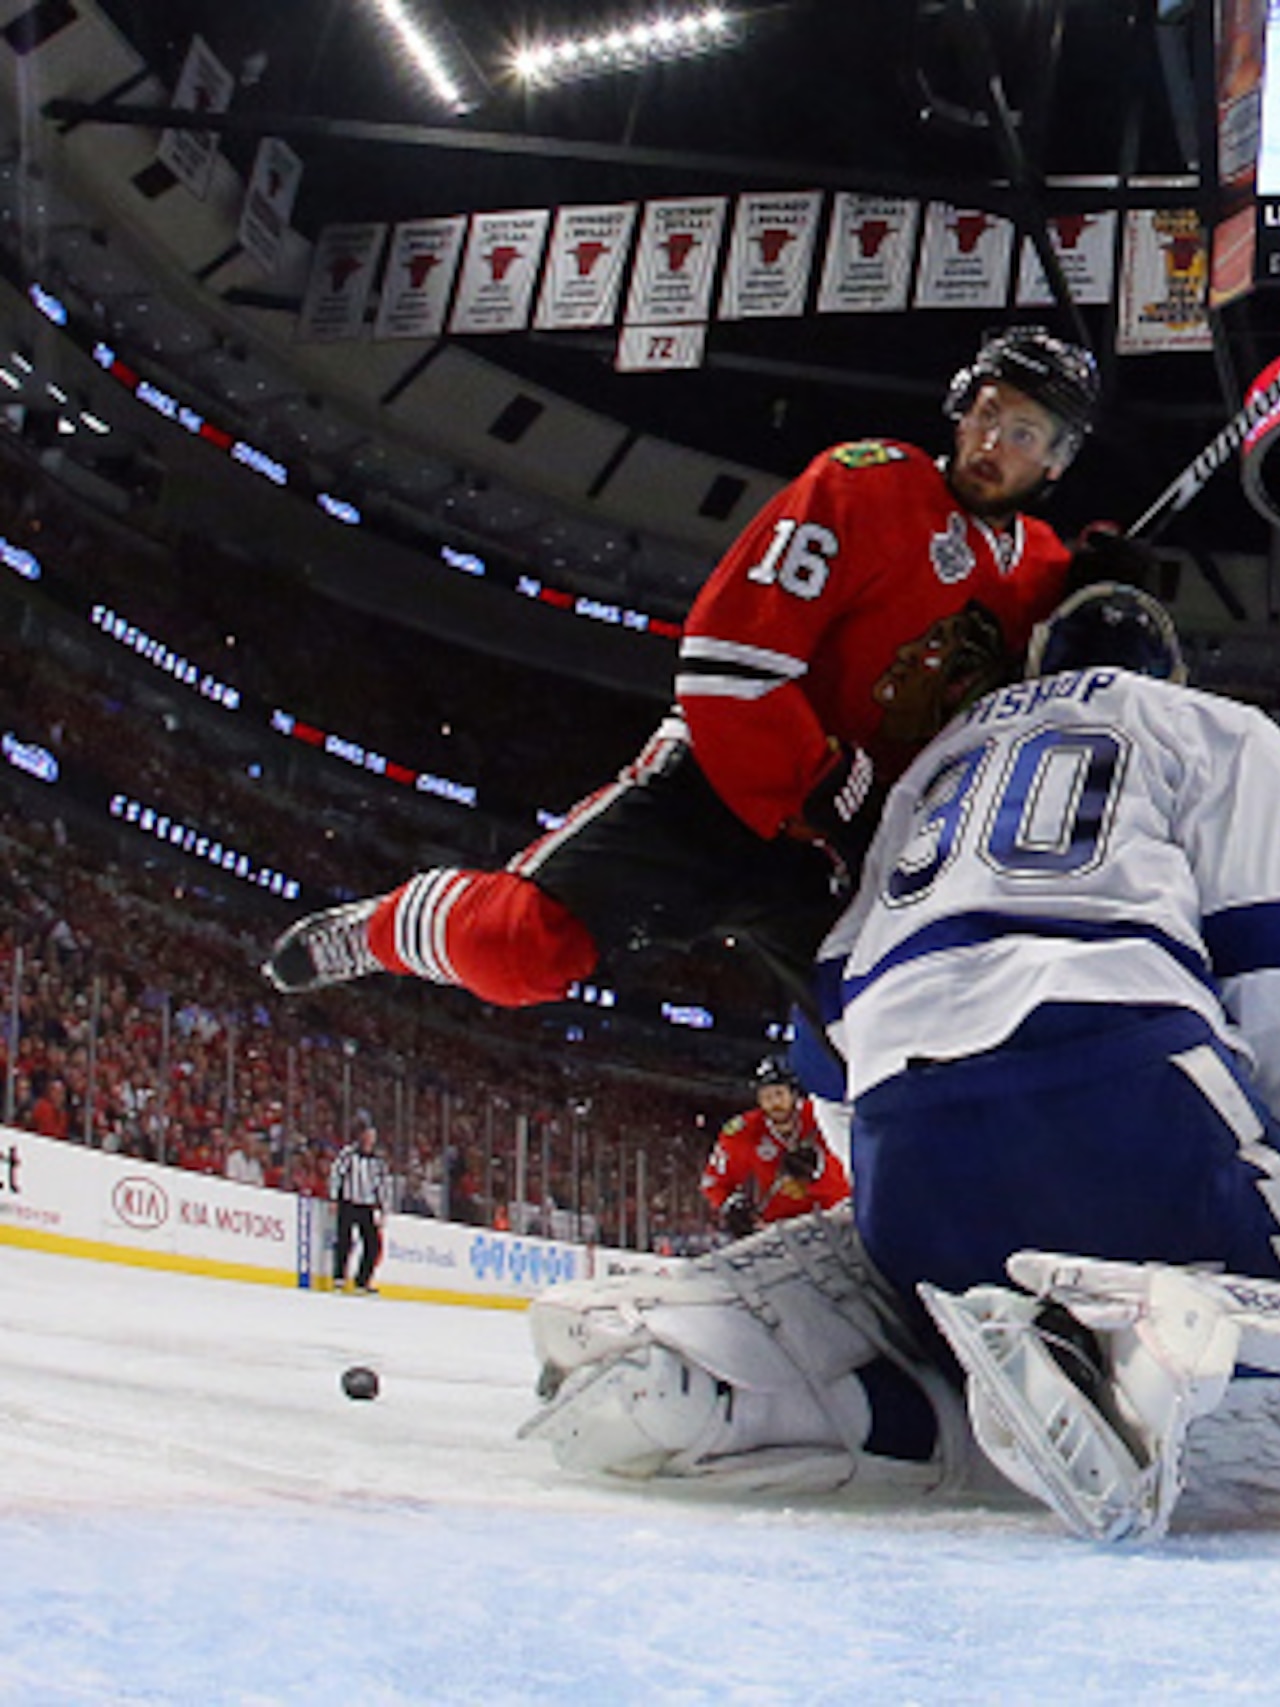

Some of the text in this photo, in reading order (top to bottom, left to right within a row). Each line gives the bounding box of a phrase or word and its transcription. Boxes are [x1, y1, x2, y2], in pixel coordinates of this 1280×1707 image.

[747, 518, 840, 600] 16
[879, 720, 1134, 910] 30
[122, 1186, 162, 1221] KIA
